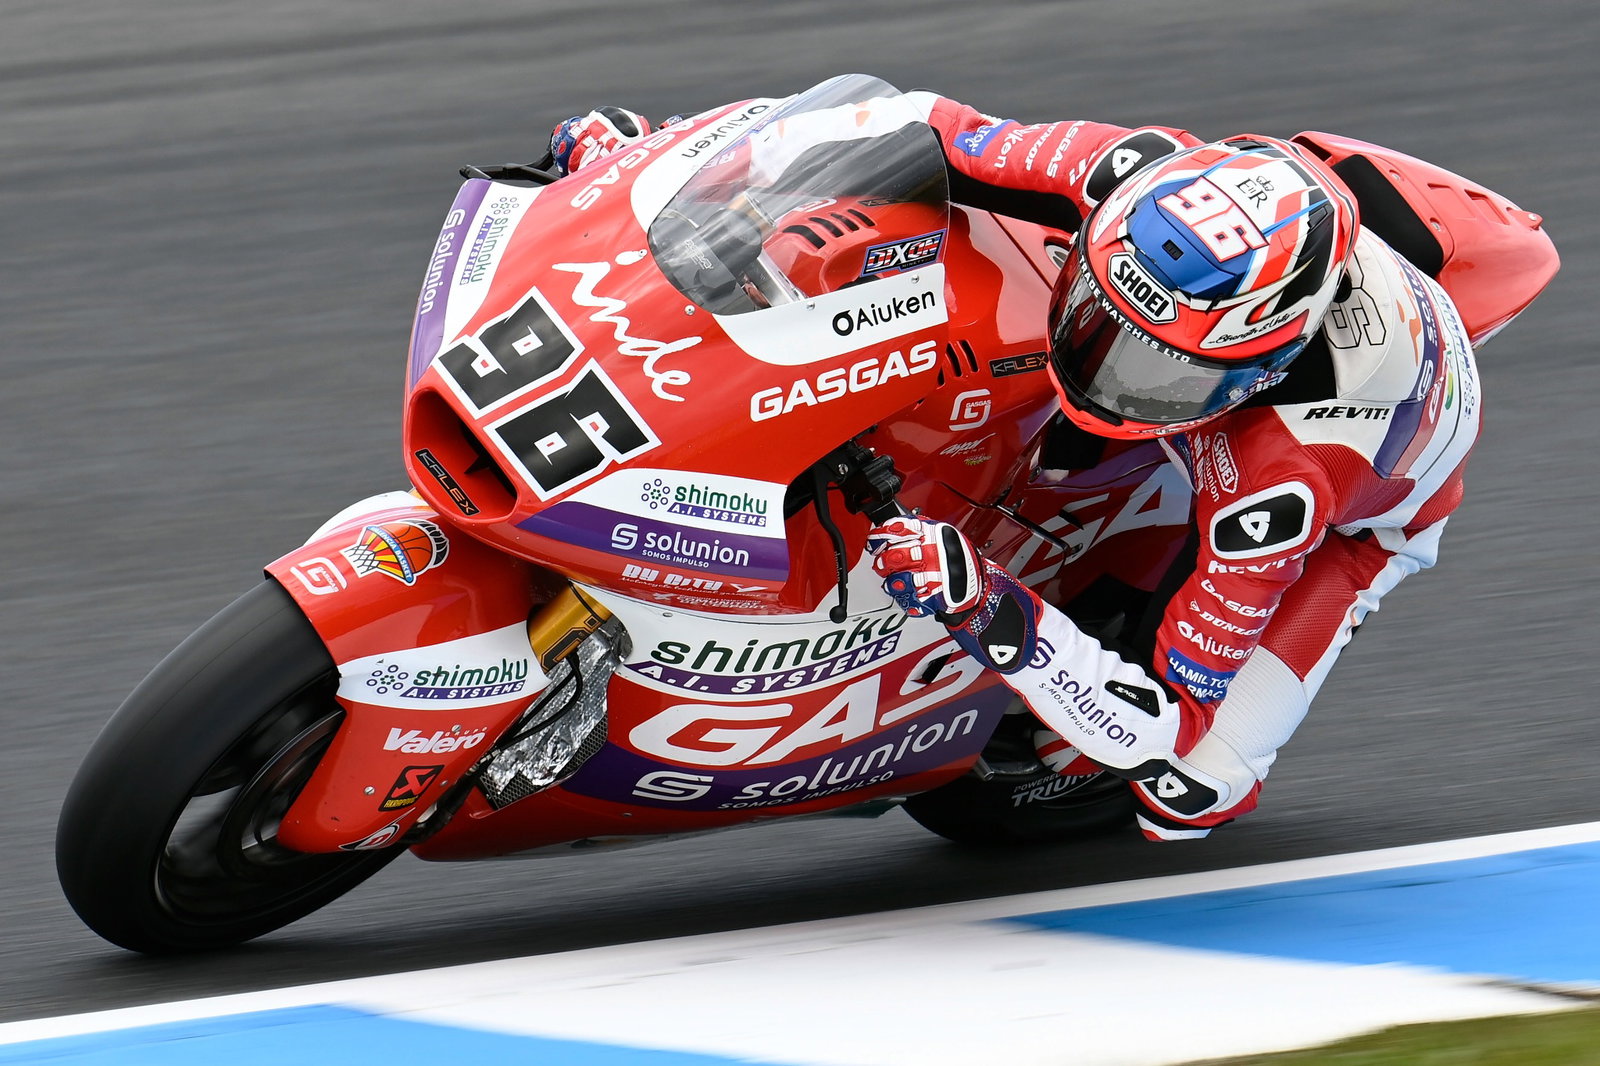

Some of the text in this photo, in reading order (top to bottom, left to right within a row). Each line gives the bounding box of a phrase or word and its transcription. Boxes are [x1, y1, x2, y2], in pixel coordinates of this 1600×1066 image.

[1156, 176, 1269, 263] 96
[420, 232, 455, 315] solunion
[471, 217, 508, 282] shimoku
[856, 291, 936, 331] Aiuken
[1079, 255, 1191, 363] TRADE WATCHES LTD
[1113, 260, 1170, 318] SHOEI
[750, 340, 937, 423] GASGAS
[992, 354, 1048, 374] KALEX
[432, 286, 662, 502] 96
[1303, 406, 1390, 420] REV'IT!
[418, 450, 476, 513] KALEX
[674, 484, 768, 515] shimoku
[671, 505, 766, 527] A.I. SYSTEMS
[642, 549, 710, 569] SOMOS IMPULSO
[643, 532, 749, 567] solunion
[638, 635, 899, 693] A.I. SYSTEMS
[650, 614, 908, 674] shimoku
[406, 681, 524, 698] A.I. SYSTEMS
[413, 658, 528, 687] shimoku
[1050, 669, 1137, 748] solunion
[1063, 705, 1095, 736] IMPULSO
[383, 727, 486, 753] Valero
[733, 709, 979, 800] solunion
[717, 770, 894, 810] SOMOS IMPULSO
